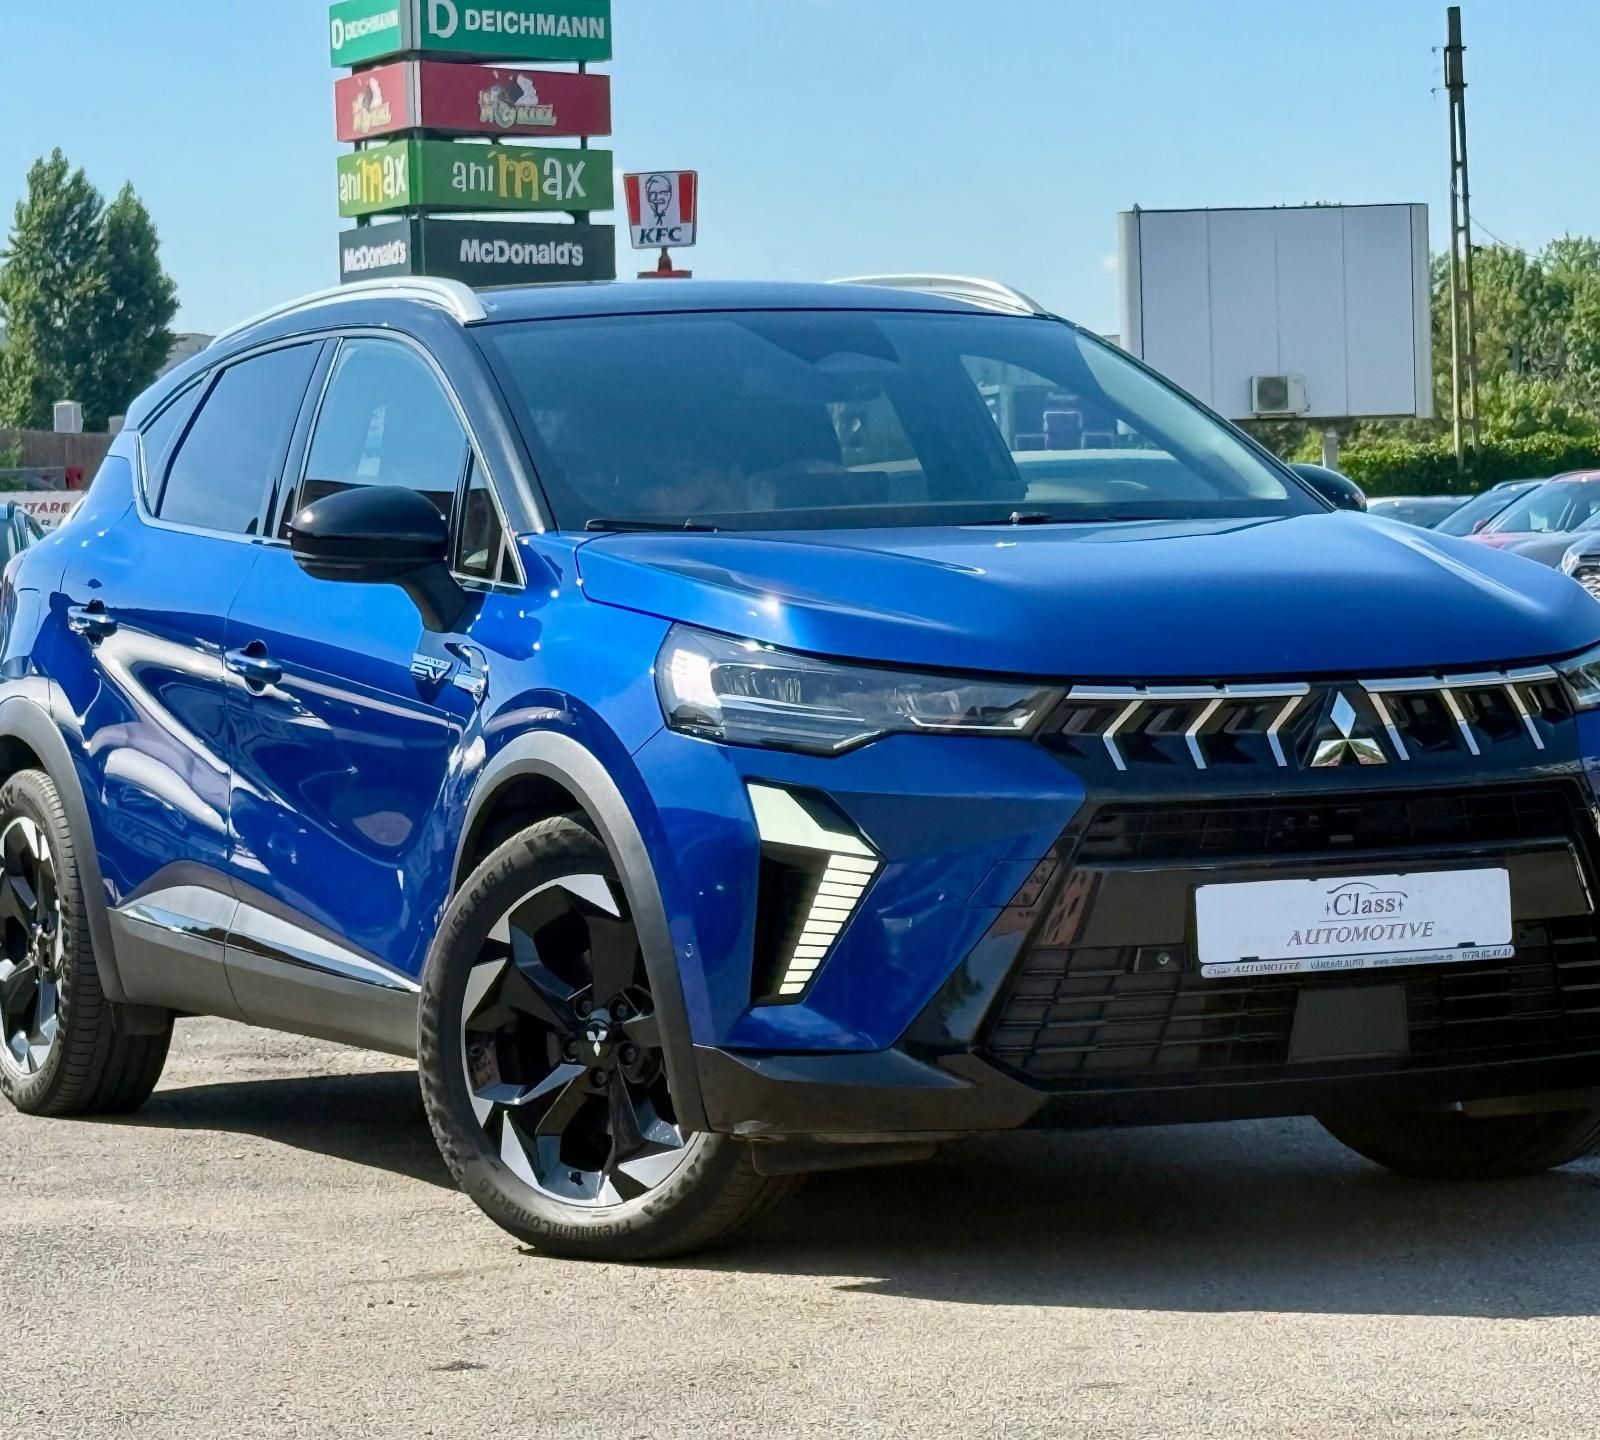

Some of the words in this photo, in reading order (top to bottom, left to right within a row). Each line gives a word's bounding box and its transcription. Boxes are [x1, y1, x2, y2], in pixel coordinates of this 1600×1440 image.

[465, 9, 605, 40] DEICHMANN
[339, 153, 407, 204] animax
[452, 151, 586, 201] animax
[639, 226, 682, 244] KFC
[459, 239, 584, 267] McDonald's
[1333, 893, 1396, 915] Class
[1286, 921, 1435, 947] AUTOMOTIVE
